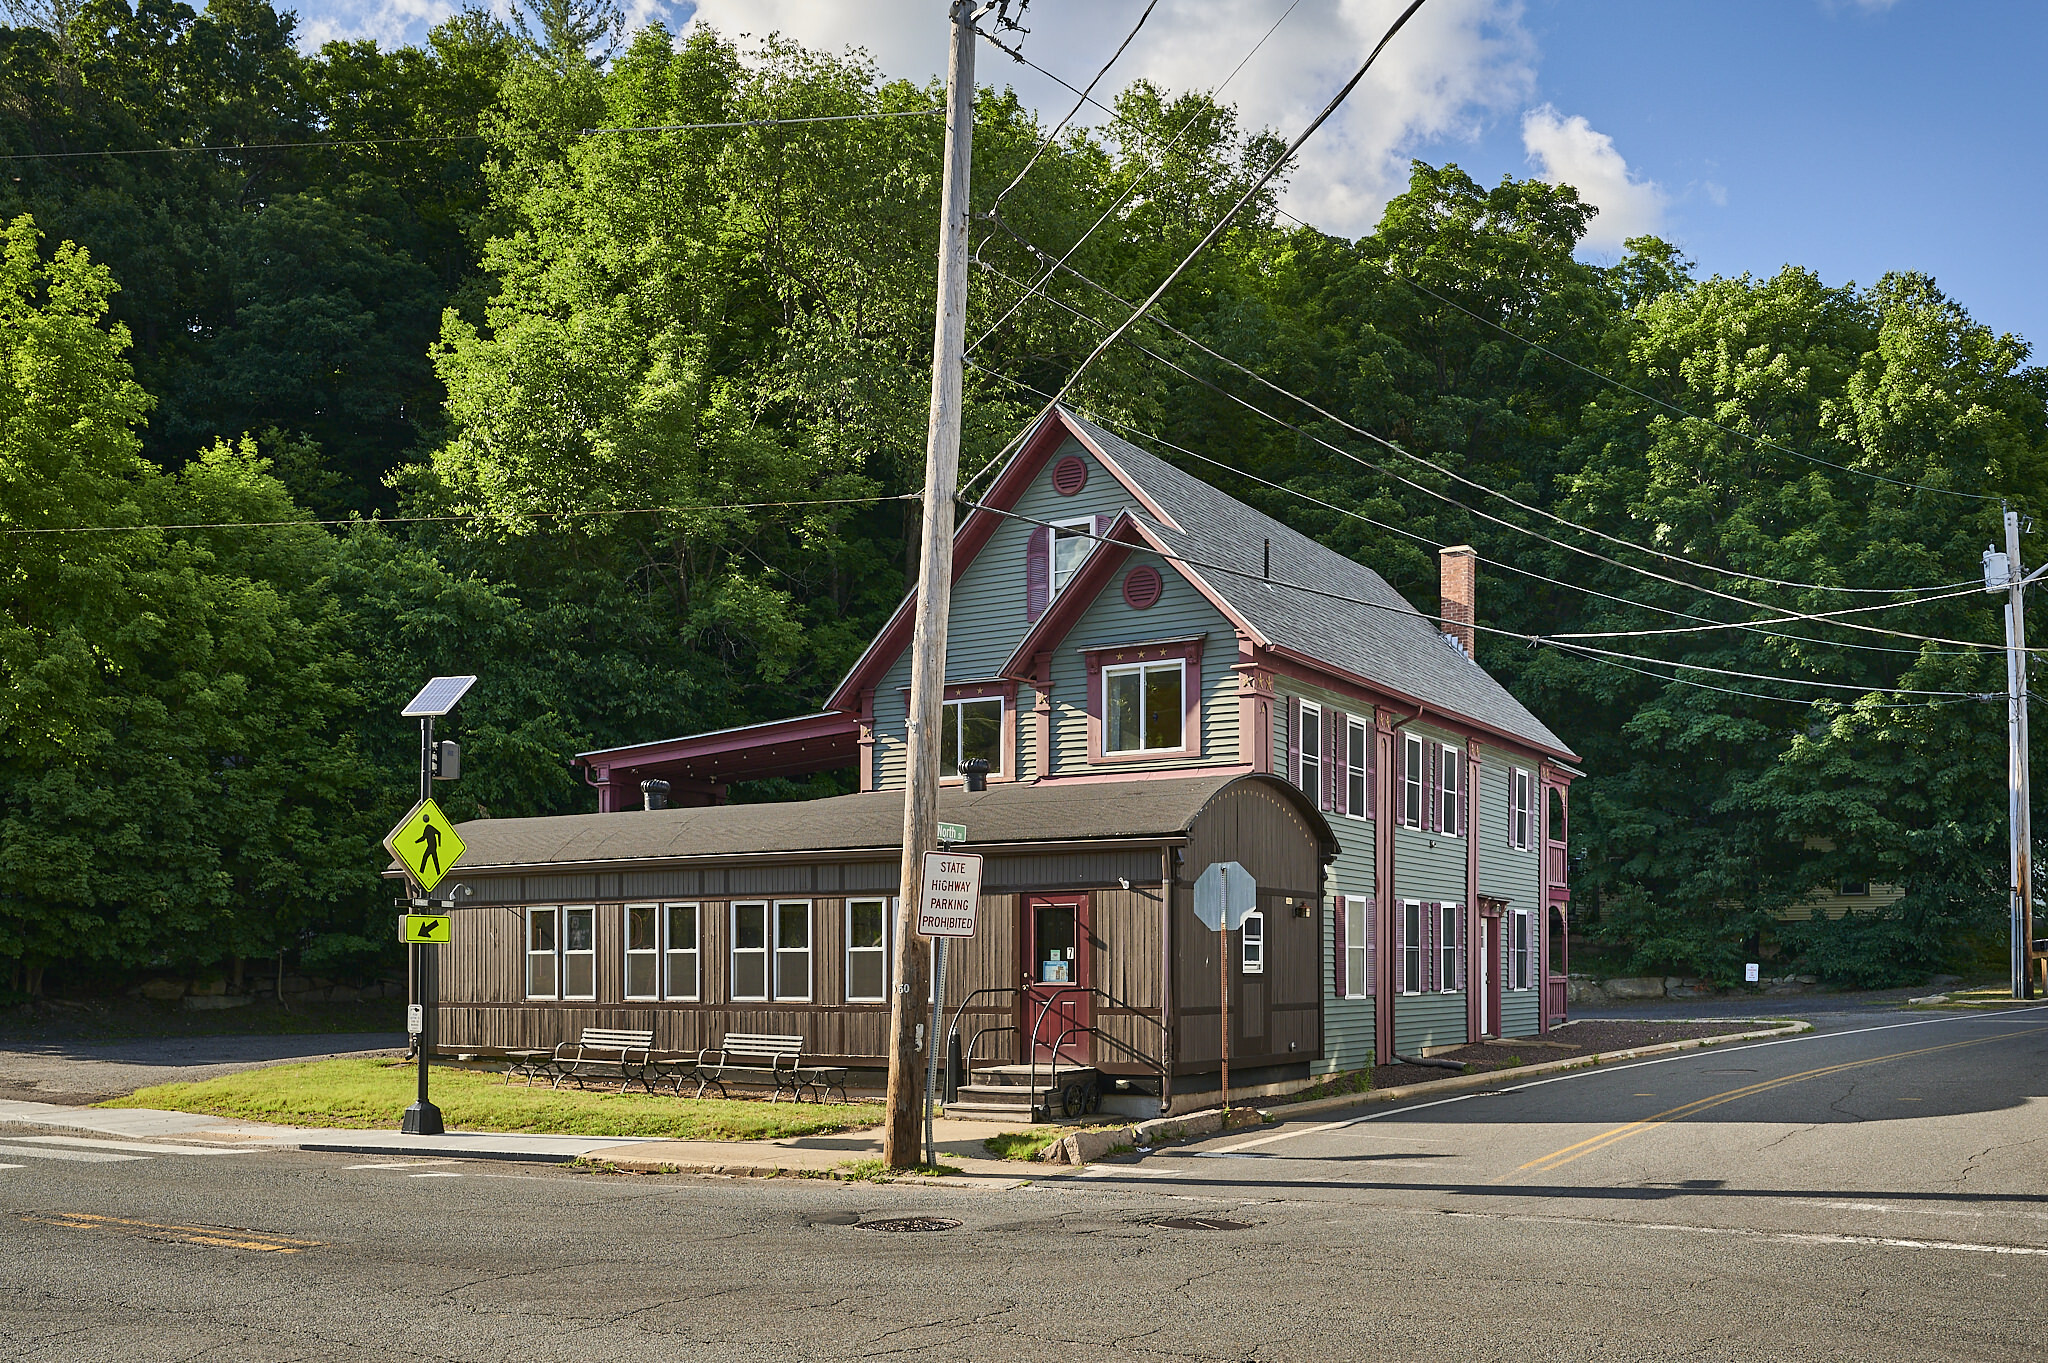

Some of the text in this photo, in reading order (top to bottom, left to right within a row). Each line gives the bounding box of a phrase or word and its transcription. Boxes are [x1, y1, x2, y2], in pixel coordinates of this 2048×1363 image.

[937, 824, 956, 839] North
[940, 861, 966, 874] STATE
[931, 880, 971, 892] HIGHWAY
[930, 898, 969, 911] PARKING
[922, 916, 973, 929] PROHIBITED
